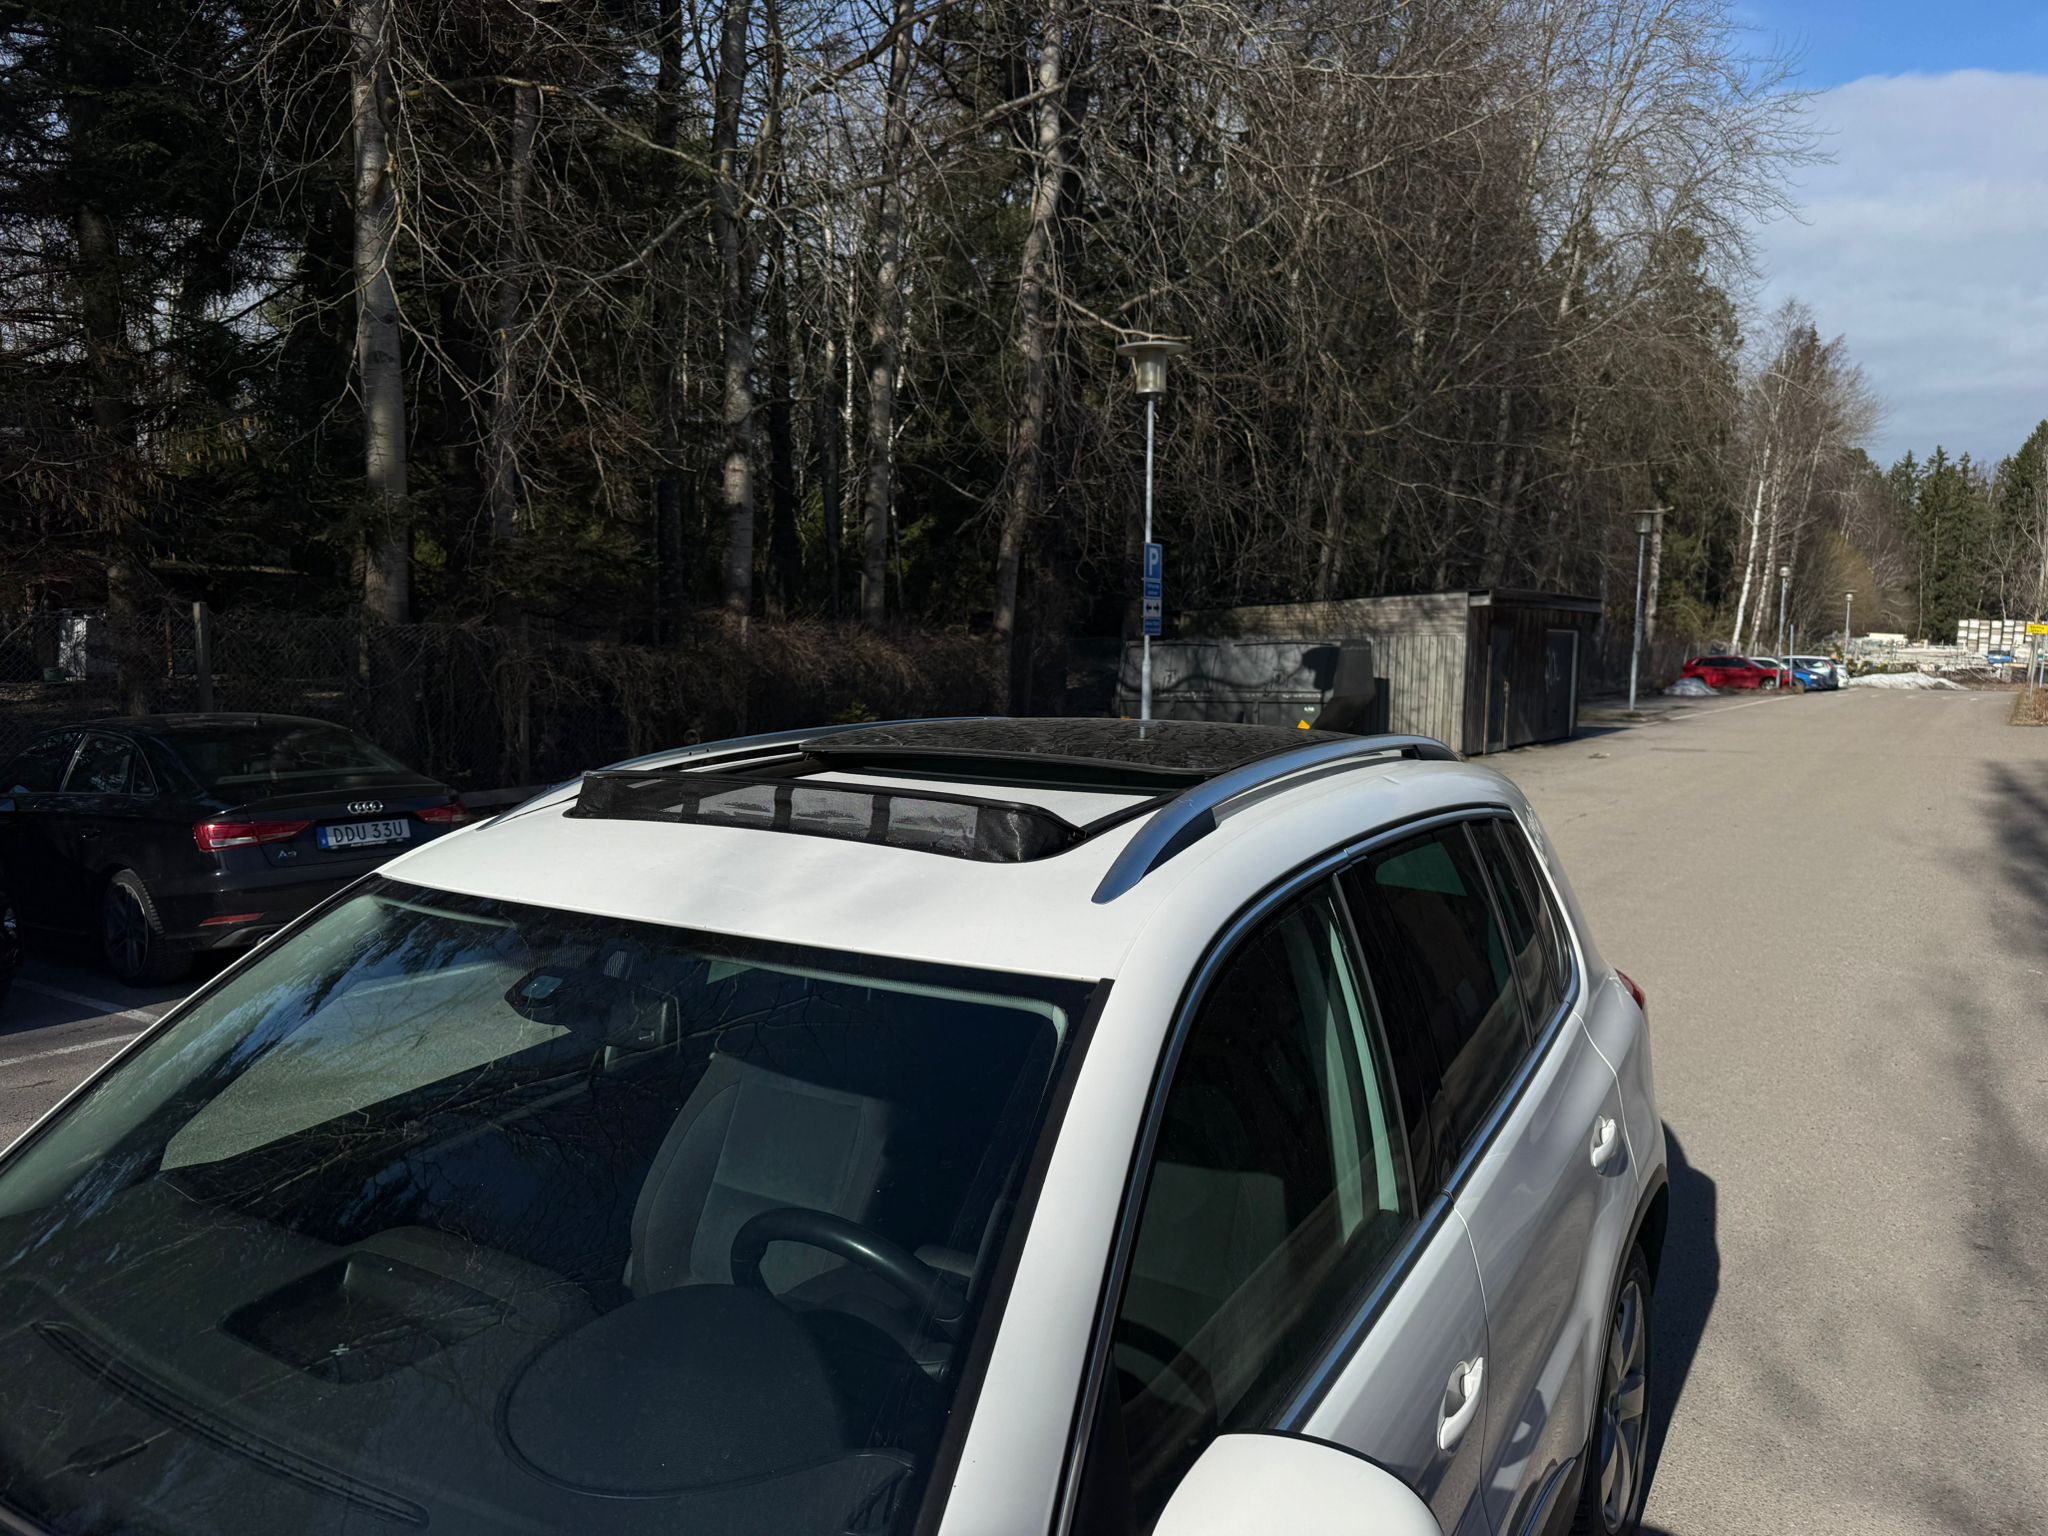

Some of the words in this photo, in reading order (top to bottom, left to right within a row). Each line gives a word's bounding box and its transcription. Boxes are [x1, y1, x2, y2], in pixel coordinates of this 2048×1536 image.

[1149, 547, 1159, 576] P
[333, 826, 366, 843] DDU
[371, 821, 403, 838] 33U
